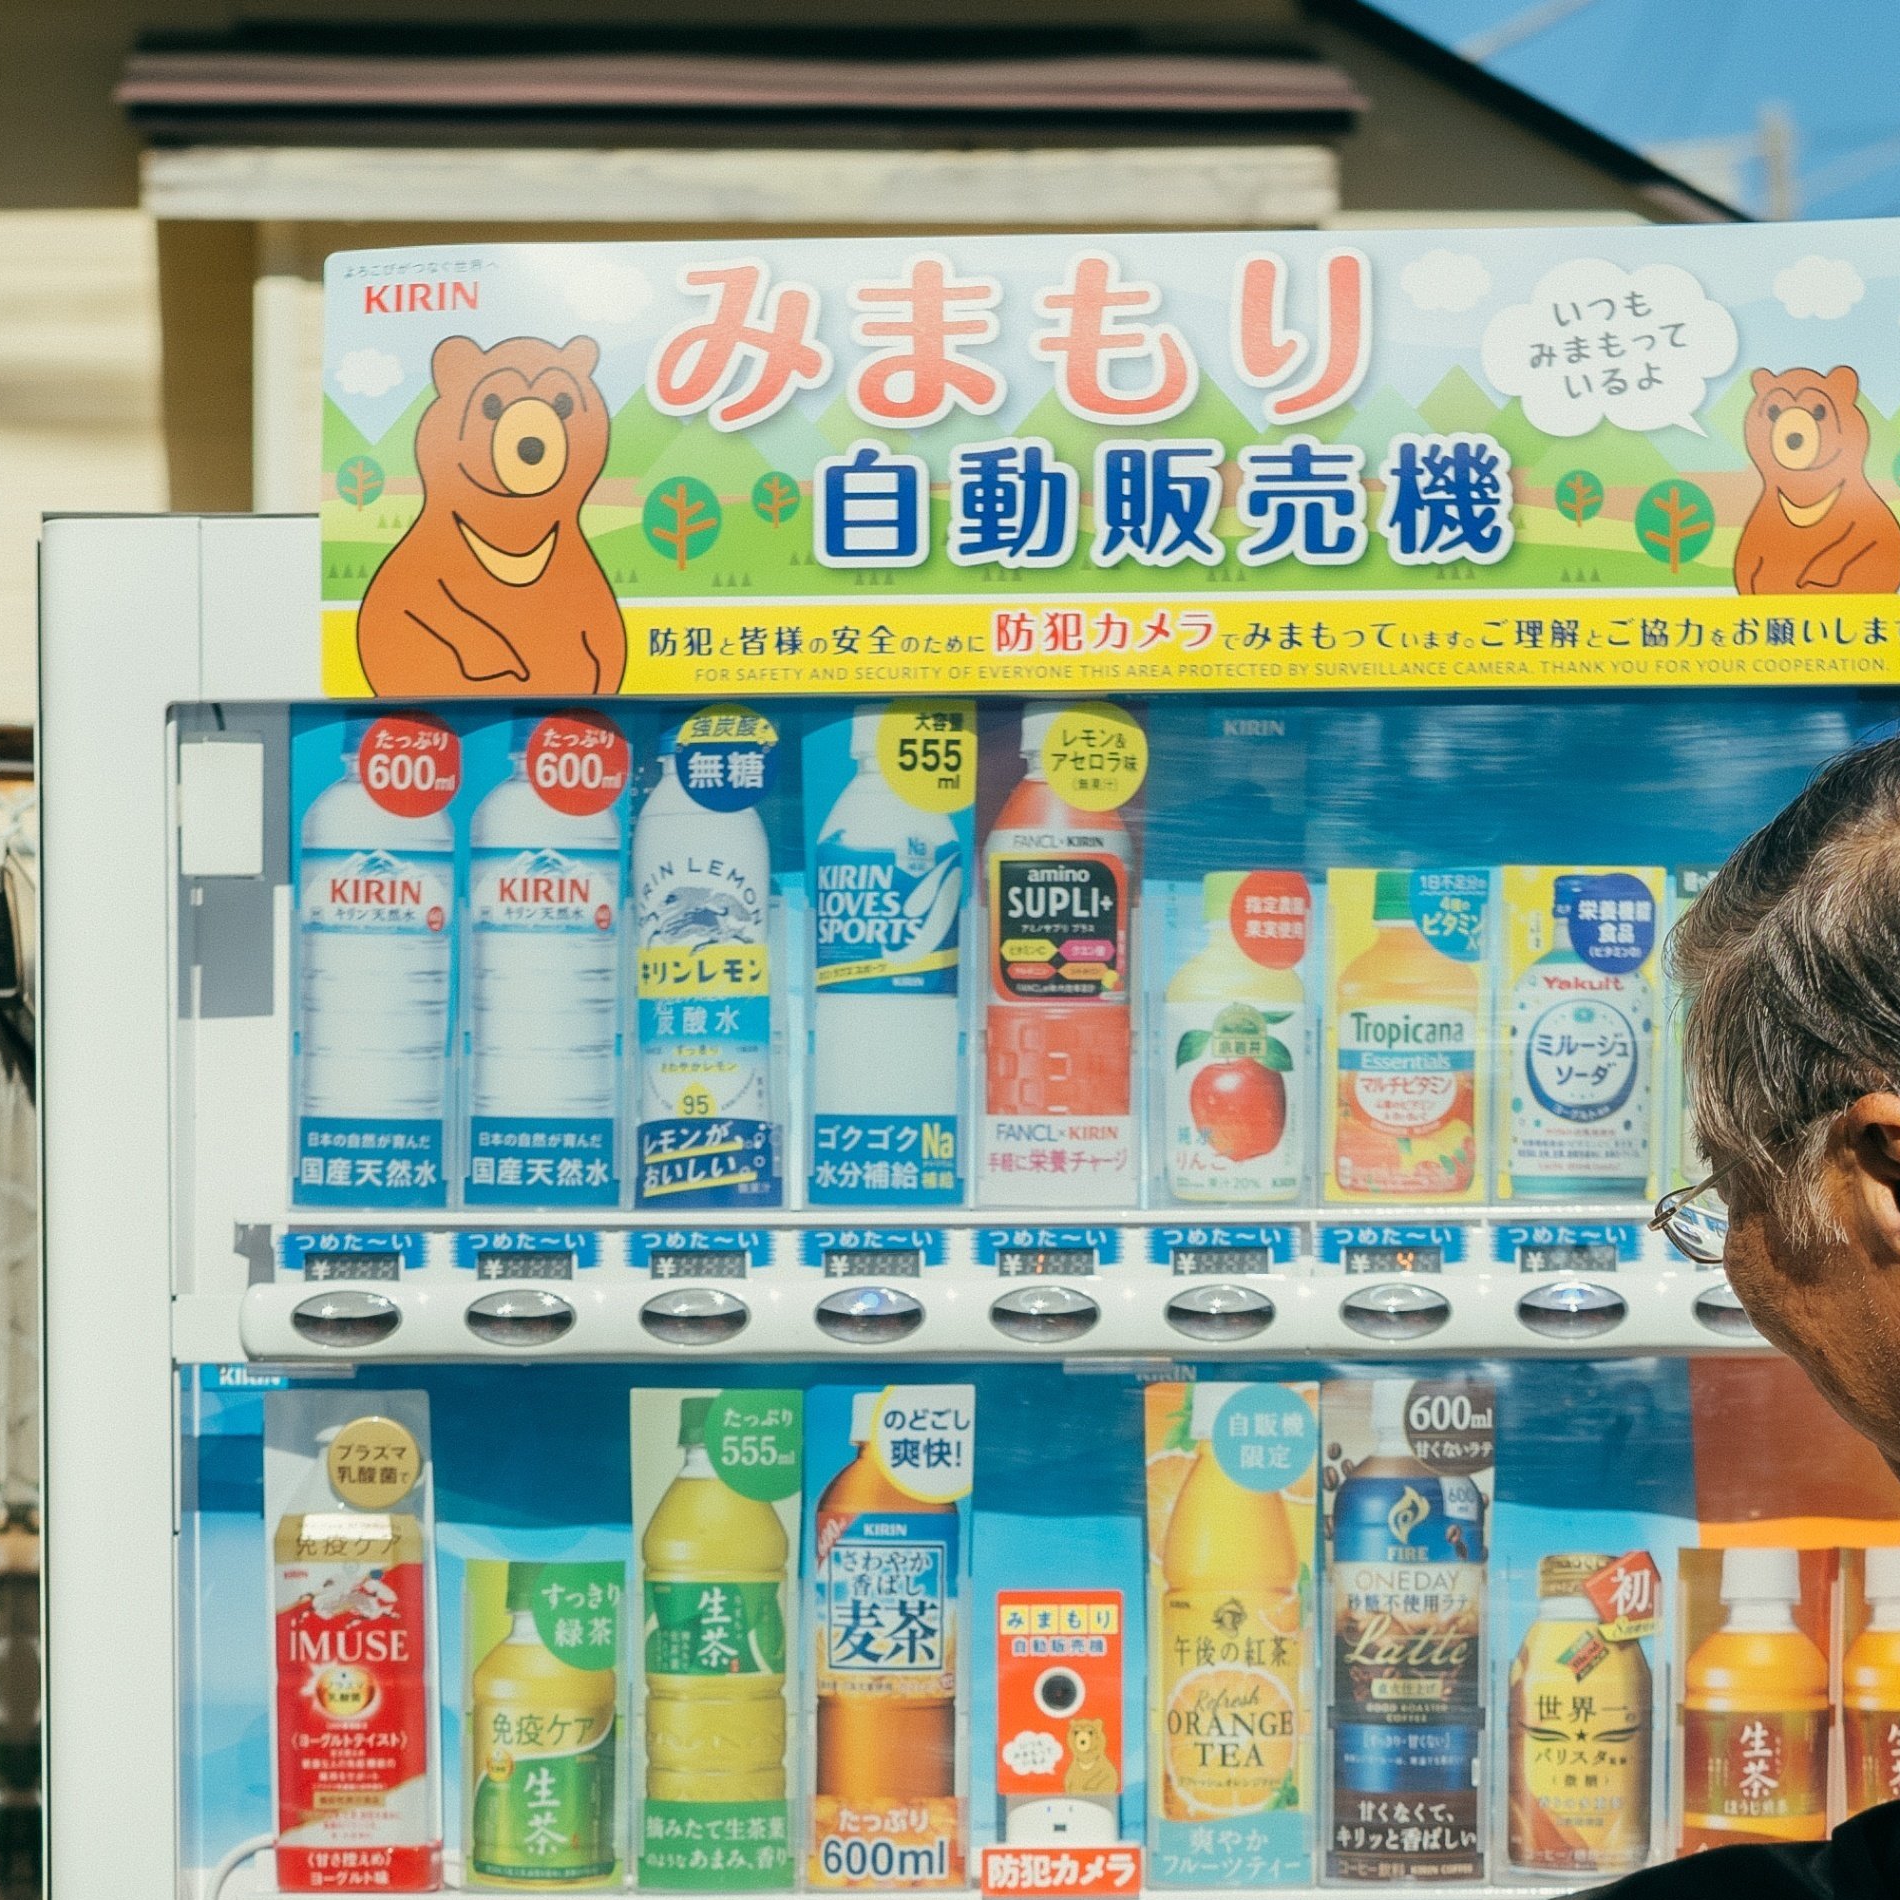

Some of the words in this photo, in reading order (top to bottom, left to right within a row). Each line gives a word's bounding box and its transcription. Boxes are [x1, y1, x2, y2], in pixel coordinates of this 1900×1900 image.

[364, 281, 479, 314] KIRIN
[1552, 290, 1654, 326] いつも
[655, 254, 1363, 422] みまもり
[1529, 322, 1690, 370] みまもって
[1563, 362, 1664, 399] いるよ
[825, 441, 1501, 559] 自動販売機
[695, 667, 732, 682] FOR
[735, 667, 802, 682] SAFETY
[811, 666, 849, 681] AND
[855, 665, 942, 680] SECURITY
[948, 665, 972, 679] OF
[979, 664, 1072, 679] EVERYONE
[1081, 664, 1121, 678] THIS
[1127, 663, 1172, 677] AREA
[1178, 662, 1281, 677] PROTECTED
[1289, 662, 1309, 676] BY
[1315, 661, 1447, 676] SURVEILLANCE
[1453, 660, 1535, 675] CAMERA.
[1541, 659, 1604, 674] THANK
[1610, 659, 1648, 674] YOU
[1656, 659, 1691, 673] FOR
[1697, 658, 1746, 673] YOUR
[1753, 657, 1890, 673] COOPERATION.
[914, 712, 963, 732] 大容量
[1223, 718, 1286, 737] KIRIN
[375, 728, 448, 751] たっぷり
[543, 727, 615, 749] たっぷり
[898, 738, 963, 772] 555
[1050, 751, 1139, 773] アセロラ味
[367, 754, 455, 792] 600ml
[535, 752, 623, 790] 600ml
[688, 750, 766, 789] 無糖
[938, 773, 960, 790] ml
[1067, 835, 1105, 848] KIRIN
[818, 864, 895, 890] KIRIN
[1027, 864, 1090, 883] amino
[330, 878, 422, 905] KIRIN
[499, 878, 590, 903] KIRIN
[687, 857, 762, 926] LEMON
[1008, 886, 1113, 919] SUPLI+
[818, 891, 901, 917] LOVES
[1578, 900, 1651, 921] 栄養機能
[818, 918, 924, 944] SPORTS
[1598, 923, 1635, 943] 食品
[642, 959, 763, 984] キリンレモン
[1543, 975, 1625, 991] Yakult
[653, 1002, 740, 1035] 炭酸水
[1350, 1011, 1464, 1049] Tropicana
[1536, 1032, 1629, 1058] ミルージュ
[1361, 1052, 1451, 1070] Essentials
[1556, 1061, 1618, 1086] ソーダ
[1360, 1076, 1454, 1095] マルチビタミン
[682, 1095, 709, 1115] 95
[818, 1125, 919, 1151] ゴクゴク
[921, 1122, 955, 1157] Na
[997, 1124, 1057, 1142] FANCL
[1068, 1124, 1119, 1142] KIRIN
[300, 1156, 437, 1188] 国産天然水
[471, 1155, 609, 1187] 国産天然水
[815, 1161, 920, 1190] 水分補給
[724, 1408, 793, 1427] たっぷり
[884, 1409, 970, 1432] のどごし
[1228, 1413, 1304, 1438] 自販機
[1408, 1395, 1493, 1432] 600ml
[336, 1445, 408, 1462] プラズマ
[721, 1436, 795, 1467] 555ml
[1239, 1446, 1291, 1469] 限定
[863, 1523, 908, 1537] KIRIN
[842, 1551, 930, 1573] さわやか
[1387, 1546, 1429, 1561] FIRE
[541, 1584, 620, 1608] すっきり
[853, 1573, 922, 1596] 香ばし
[1609, 1567, 1650, 1617] 初
[1347, 1592, 1468, 1613] 砂糖不使用ラテ
[698, 1586, 738, 1668] 生茶
[833, 1599, 939, 1664] 麦茶
[1006, 1609, 1111, 1631] みまもり
[554, 1620, 613, 1648] 緑茶
[1013, 1637, 1105, 1654] 自動販売機
[1344, 1613, 1469, 1666] Latte
[1174, 1636, 1289, 1667] 午後の紅茶
[492, 1712, 595, 1747] 免疫ケア
[1168, 1709, 1294, 1738] ORANGE
[1194, 1742, 1265, 1768] TEA
[1739, 1720, 1779, 1798] 生茶
[524, 1768, 567, 1854] 生茶
[837, 1808, 930, 1830] たっぷり
[1189, 1827, 1269, 1854] 爽やか
[1335, 1826, 1477, 1852] キリッと香ばしい
[823, 1839, 946, 1878] 600ml
[987, 1854, 1138, 1888] 防犯カメラ
[1162, 1855, 1300, 1879] フルーツティー
